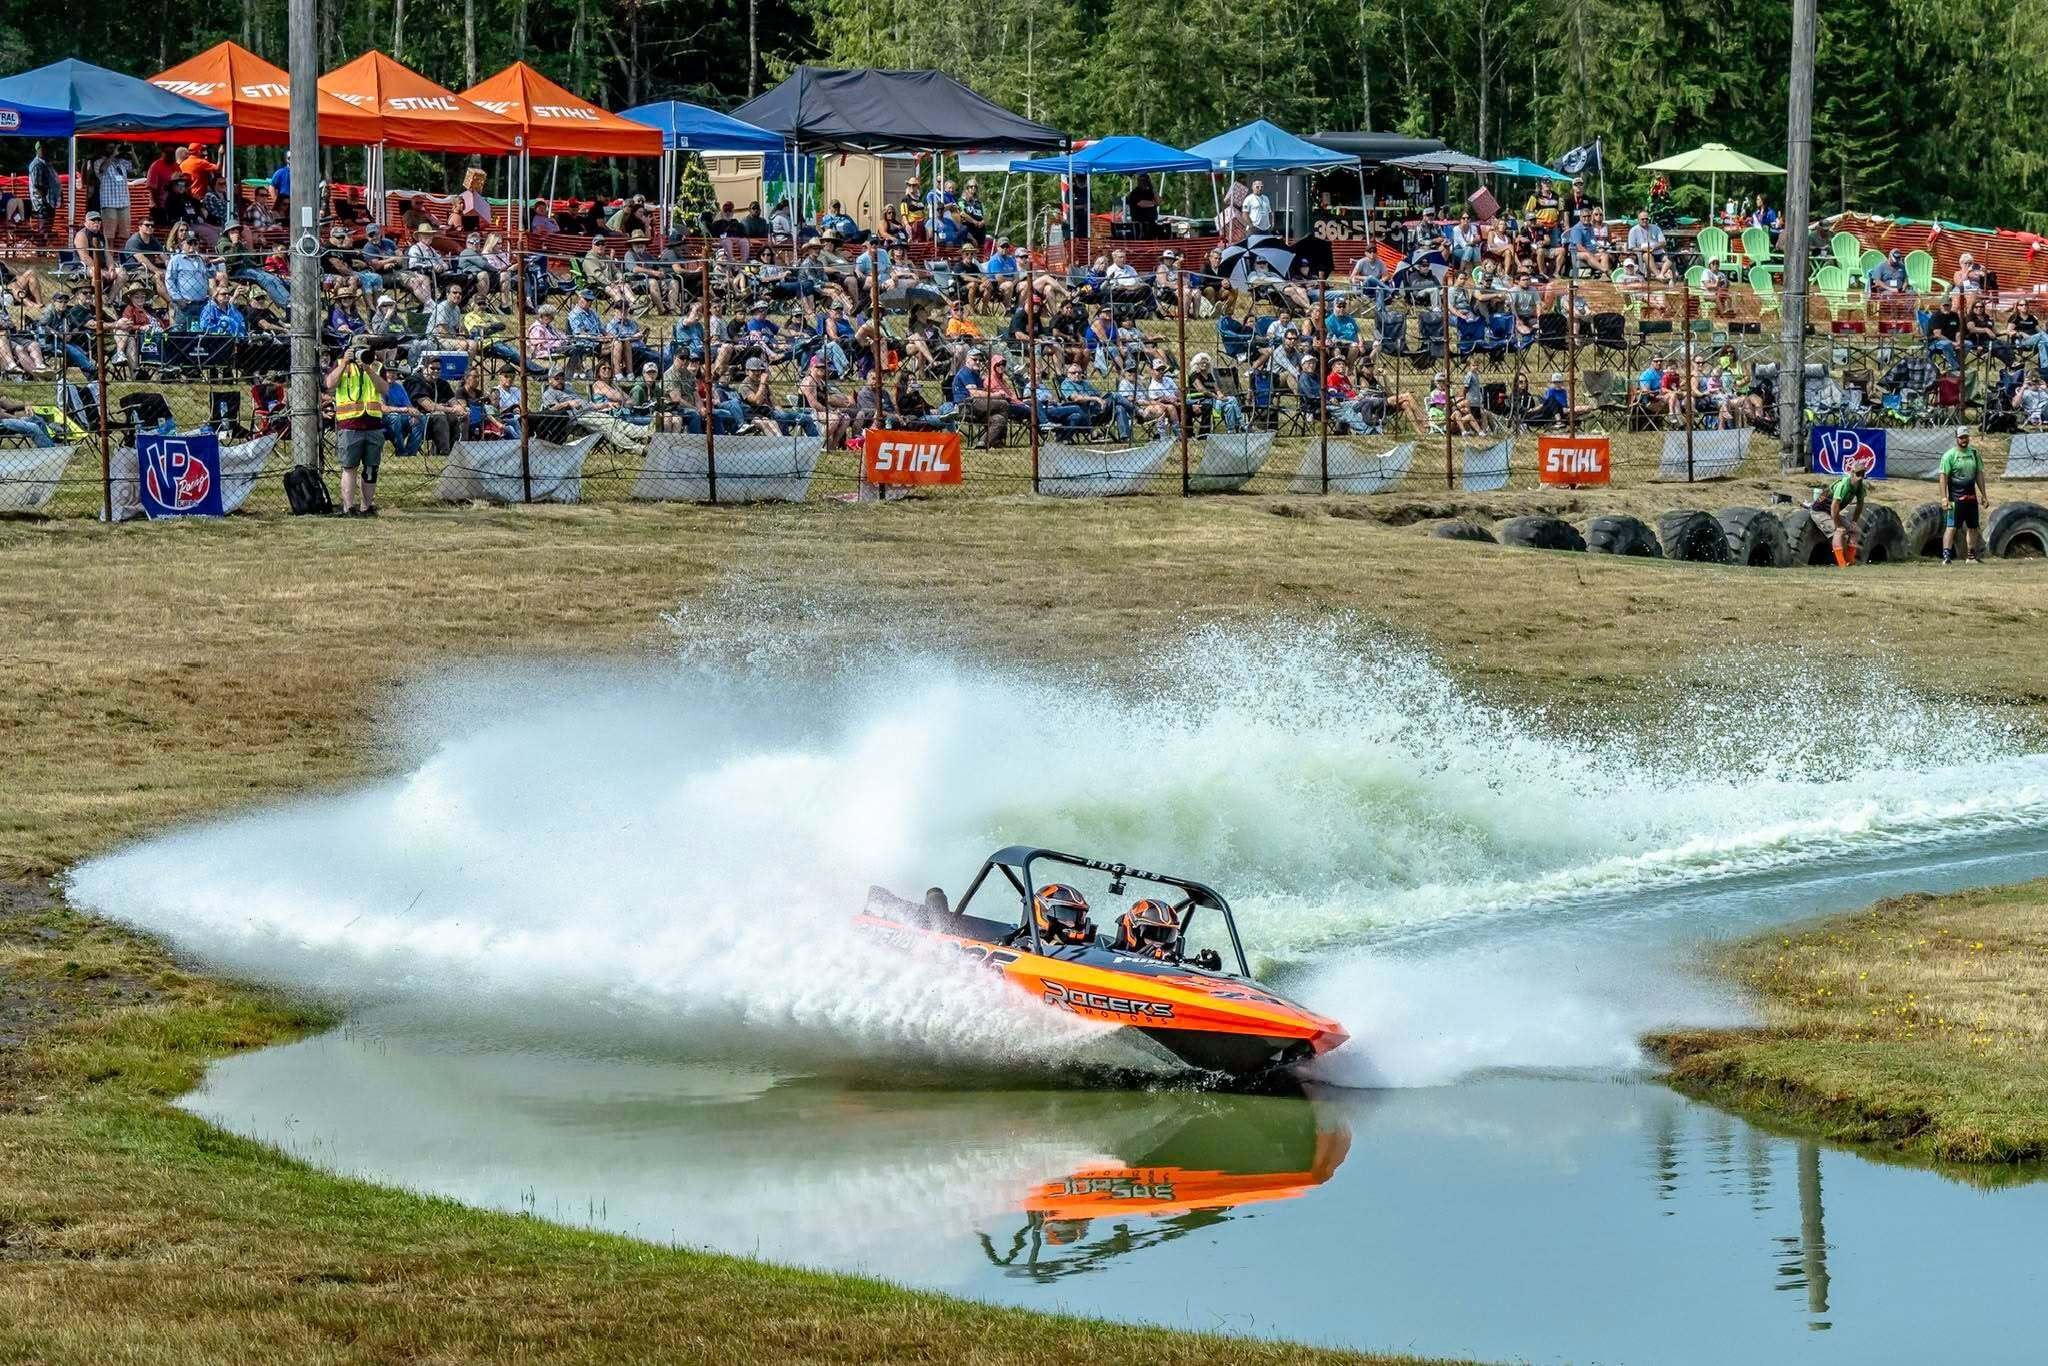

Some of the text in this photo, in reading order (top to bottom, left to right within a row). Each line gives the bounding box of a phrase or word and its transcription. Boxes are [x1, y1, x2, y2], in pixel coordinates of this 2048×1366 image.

[388, 96, 460, 111] STIHL
[532, 105, 600, 121] STIHL
[875, 442, 950, 472] STIHL
[1546, 448, 1602, 473] STIHL
[1821, 430, 1860, 473] VP
[147, 440, 190, 507] VP
[1040, 978, 1175, 1018] ROGERS
[1084, 1008, 1168, 1025] MOTORS
